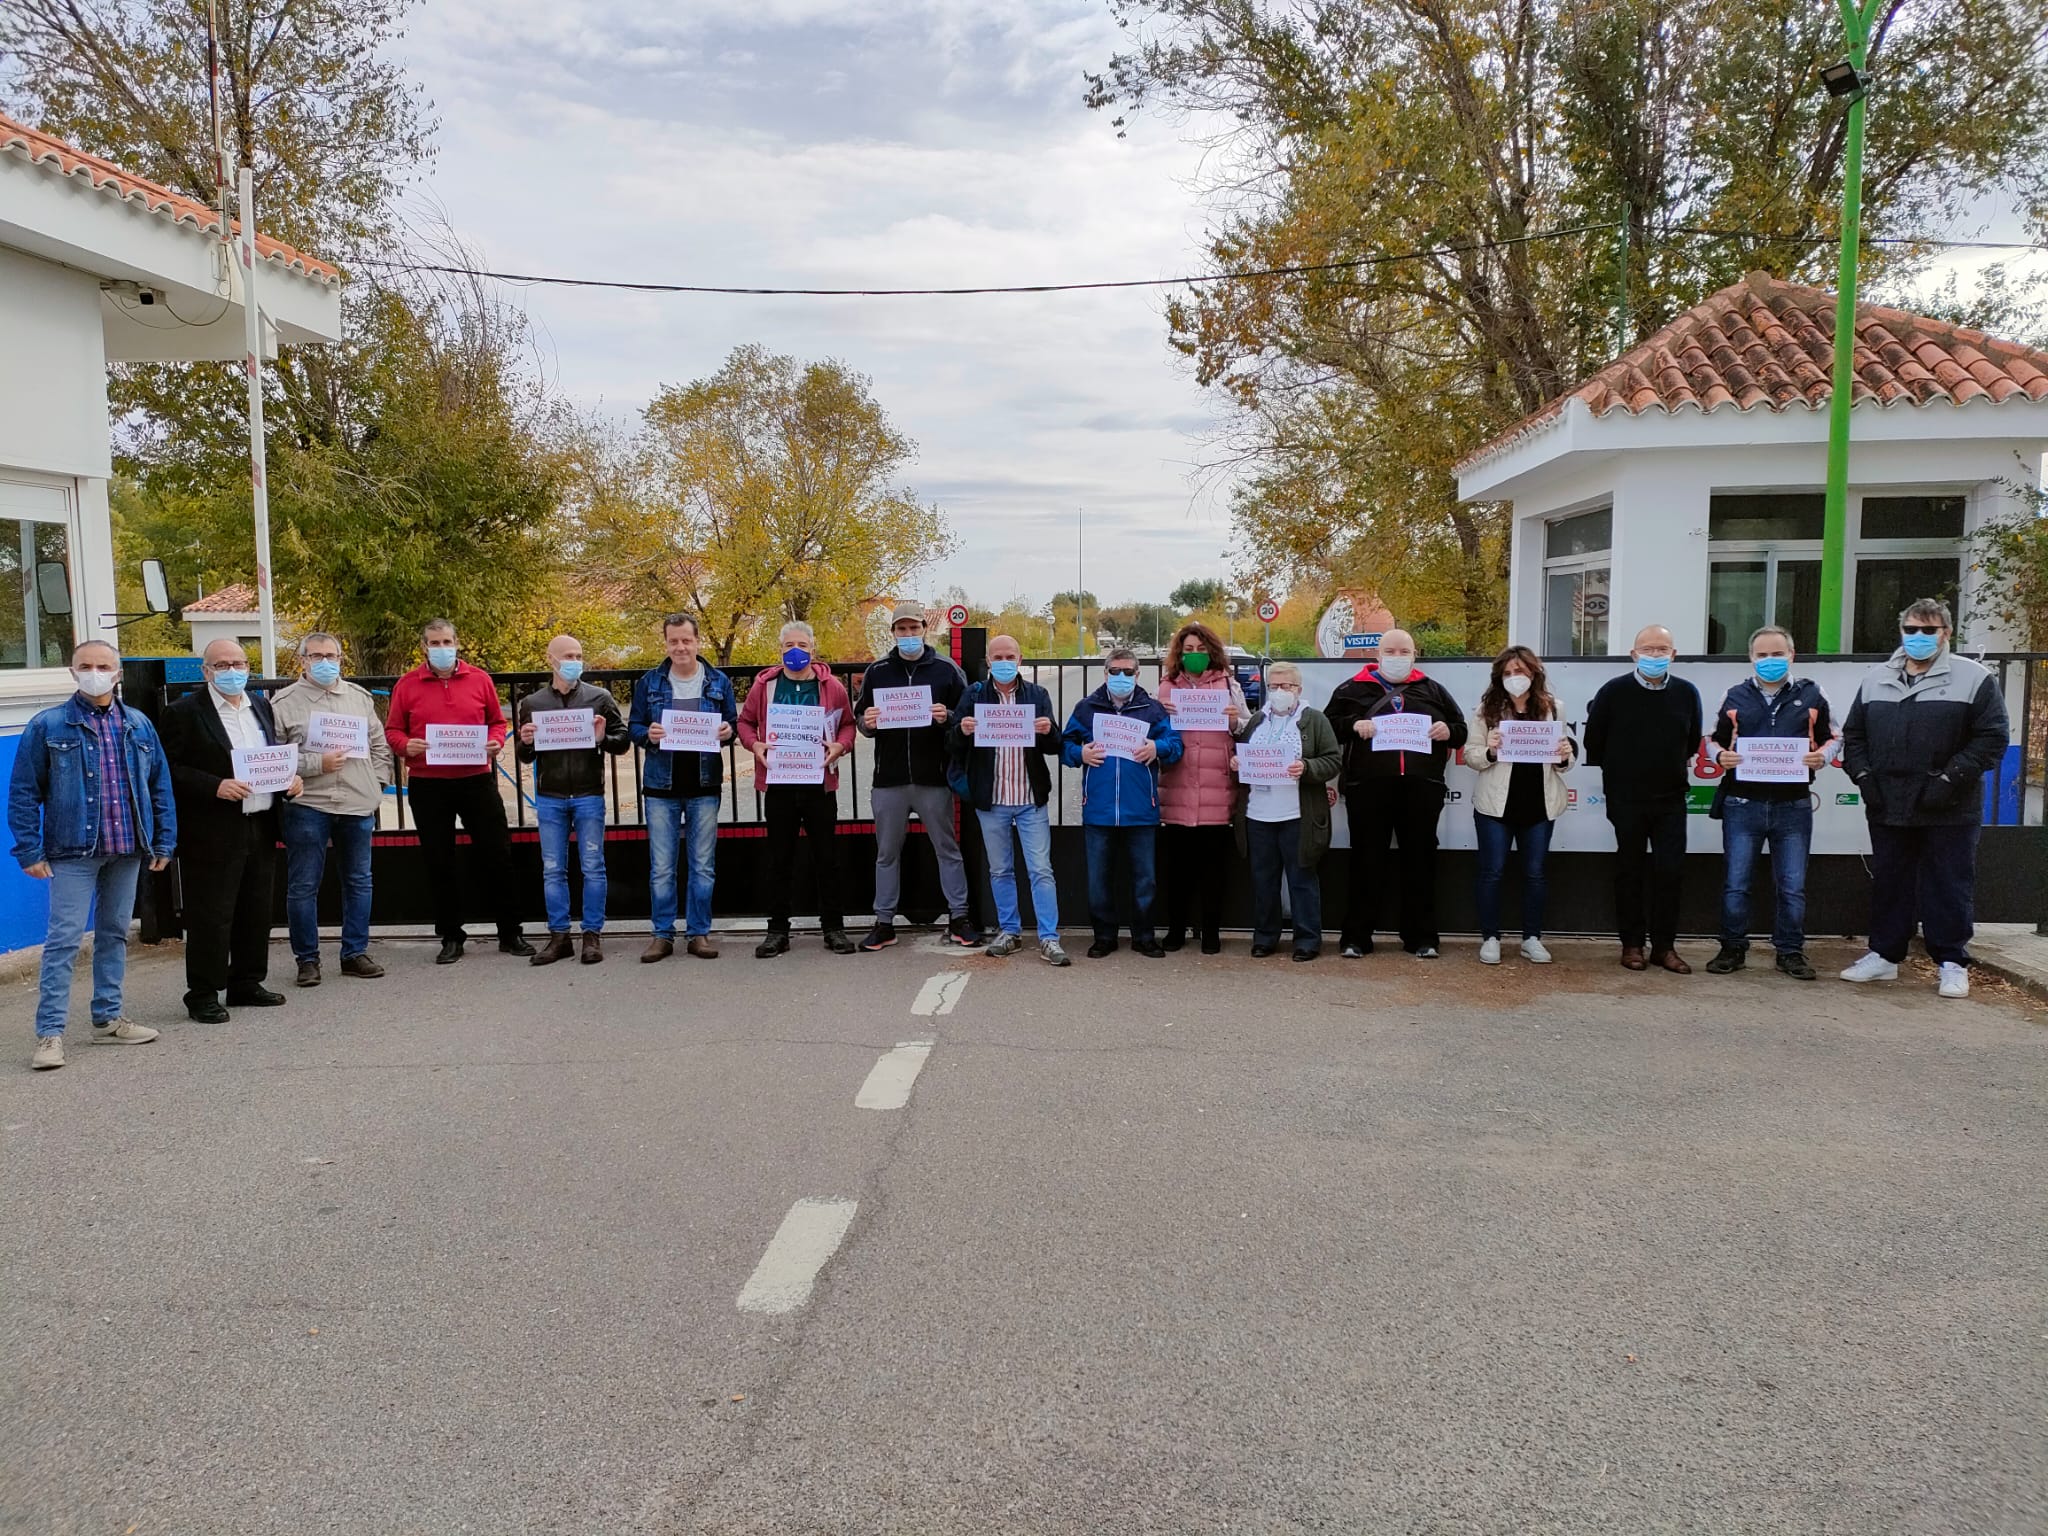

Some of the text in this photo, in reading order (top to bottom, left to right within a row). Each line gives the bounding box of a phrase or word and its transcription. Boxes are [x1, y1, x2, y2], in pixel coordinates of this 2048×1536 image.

[1262, 607, 1274, 615] 20
[882, 691, 923, 701] ¡BASTA YA!
[886, 704, 921, 712] PRISIONES
[984, 709, 1026, 718] ¡BASTA YA!
[320, 718, 360, 729] ¡BASTA YA!
[542, 715, 569, 724] ¡BASTA
[671, 715, 712, 726] ¡BASTA YA!
[1382, 718, 1423, 726] ¡BASTA YA!
[1101, 720, 1141, 732] ¡BASTA YA!
[1508, 726, 1553, 734] ¡BASTA YA!
[322, 731, 357, 740] PRISIONES
[777, 732, 813, 742] AGRESIONES
[1104, 732, 1136, 743] PRISIONES
[1388, 739, 1428, 747] AGRESIONES
[1748, 743, 1781, 751] ¡BASTA
[244, 750, 291, 763] ¡BASTA YA!
[1245, 748, 1285, 757] ¡BASTA YA!
[1752, 756, 1794, 764] PRISIONES
[249, 764, 289, 775] PRISIONES
